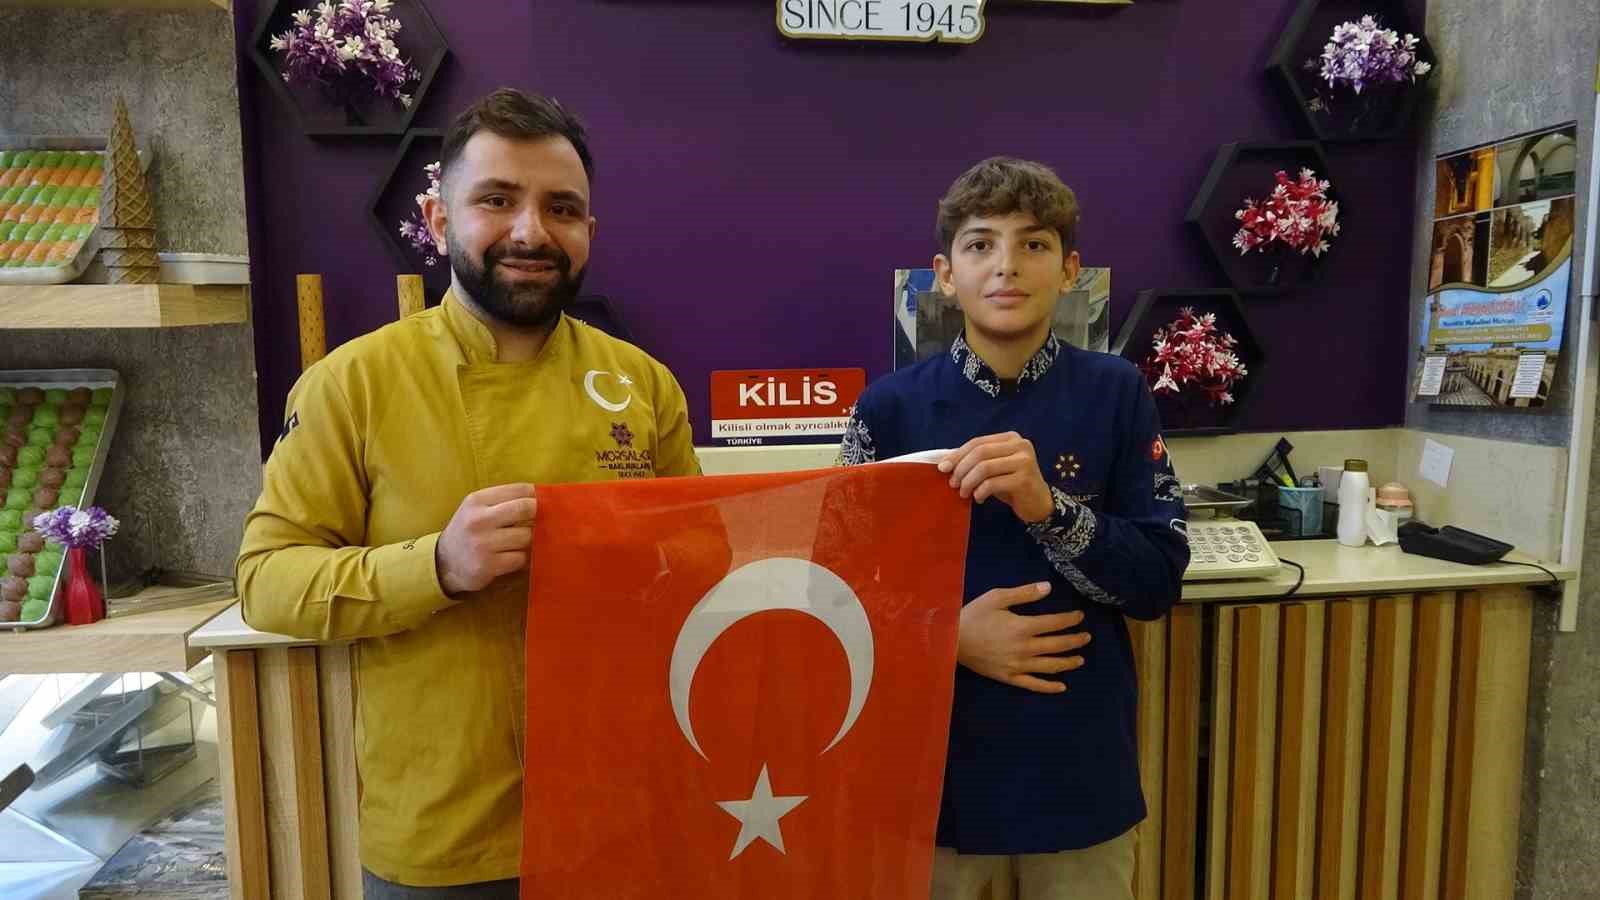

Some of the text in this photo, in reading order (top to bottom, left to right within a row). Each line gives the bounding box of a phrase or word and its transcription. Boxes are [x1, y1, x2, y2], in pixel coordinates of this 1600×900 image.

[784, 0, 978, 34] SINCE 1945
[738, 376, 838, 406] KİLİS
[718, 419, 850, 432] Kilisli olmak ayrıcalıkt
[726, 437, 763, 446] TÜRKİYE
